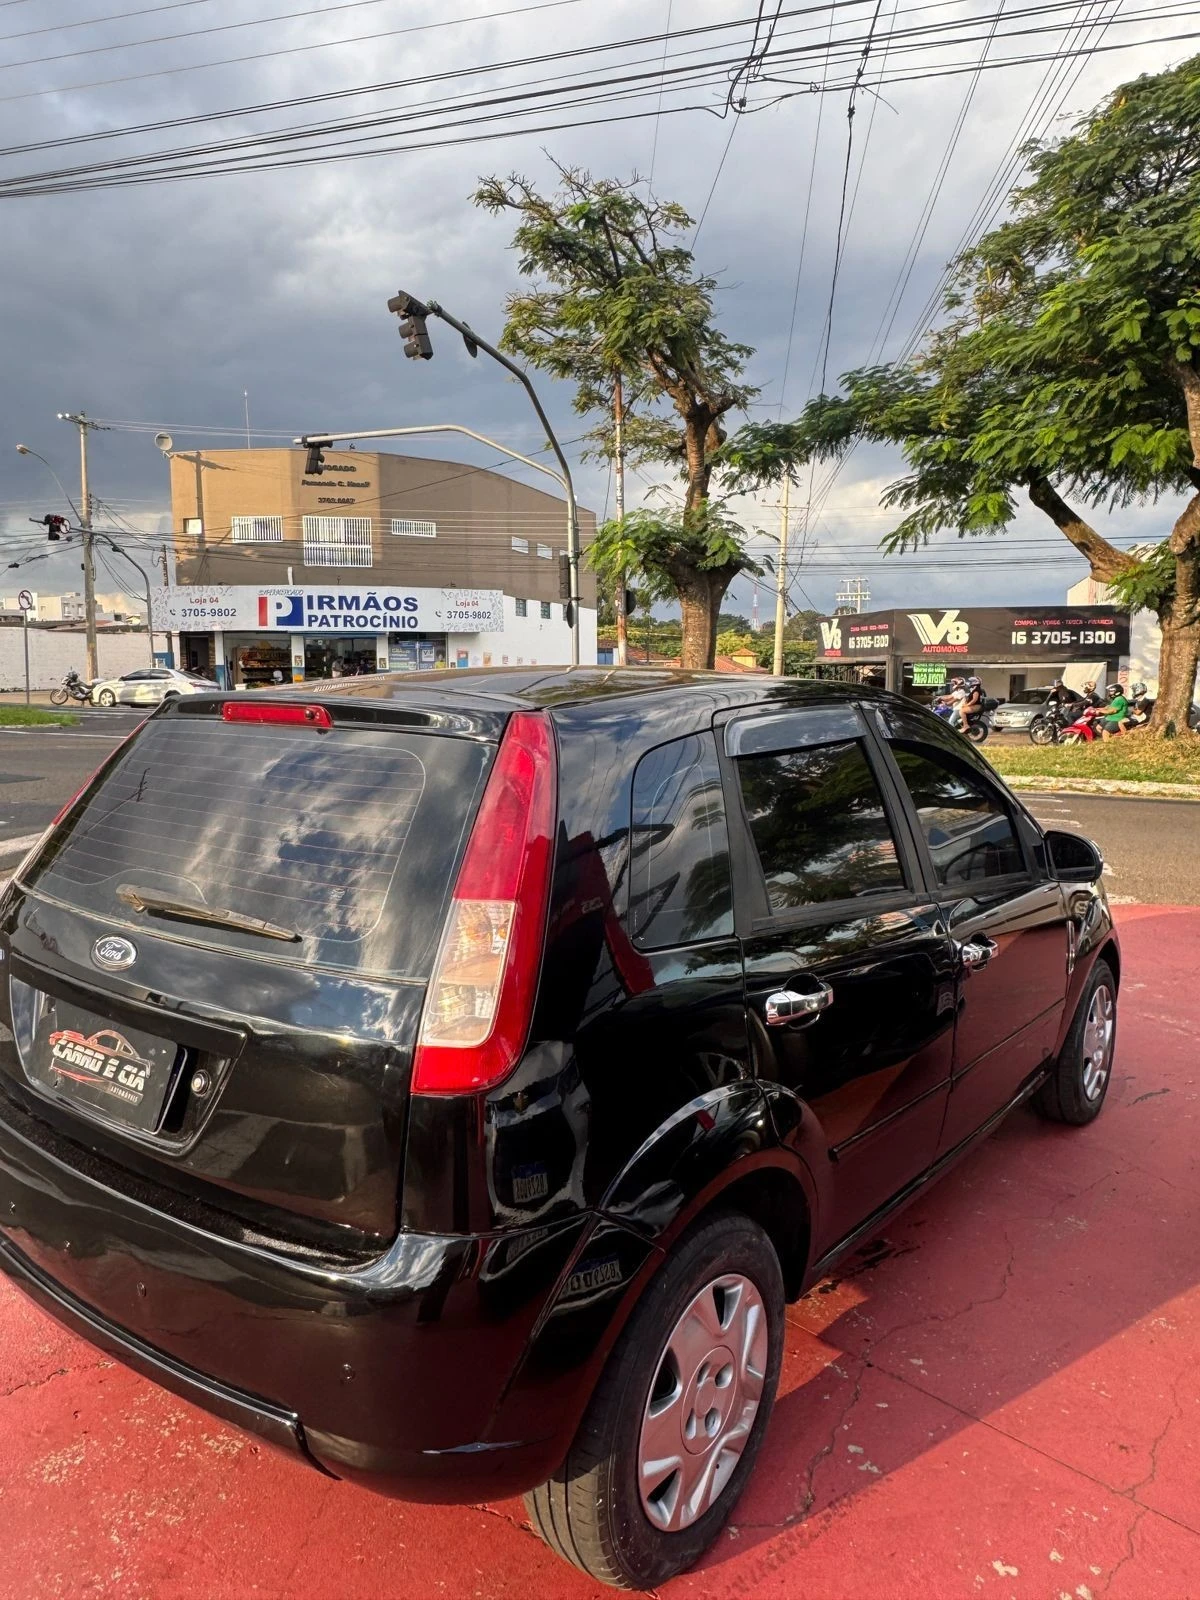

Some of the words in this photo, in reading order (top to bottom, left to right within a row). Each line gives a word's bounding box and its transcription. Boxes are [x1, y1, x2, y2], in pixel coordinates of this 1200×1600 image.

[190, 597, 206, 605] Loja
[307, 592, 418, 612] IRMÃOS
[455, 600, 470, 608] Loja
[181, 608, 237, 618] 3705-9802
[446, 610, 492, 620] 3705-9802
[308, 613, 418, 629] PATROCÍNIO
[907, 609, 969, 645] V8
[820, 618, 842, 649] V8
[1011, 631, 1027, 645] 16
[1031, 631, 1116, 645] 3705-1300
[856, 634, 889, 649] 3705-1300
[101, 942, 125, 960] Ford
